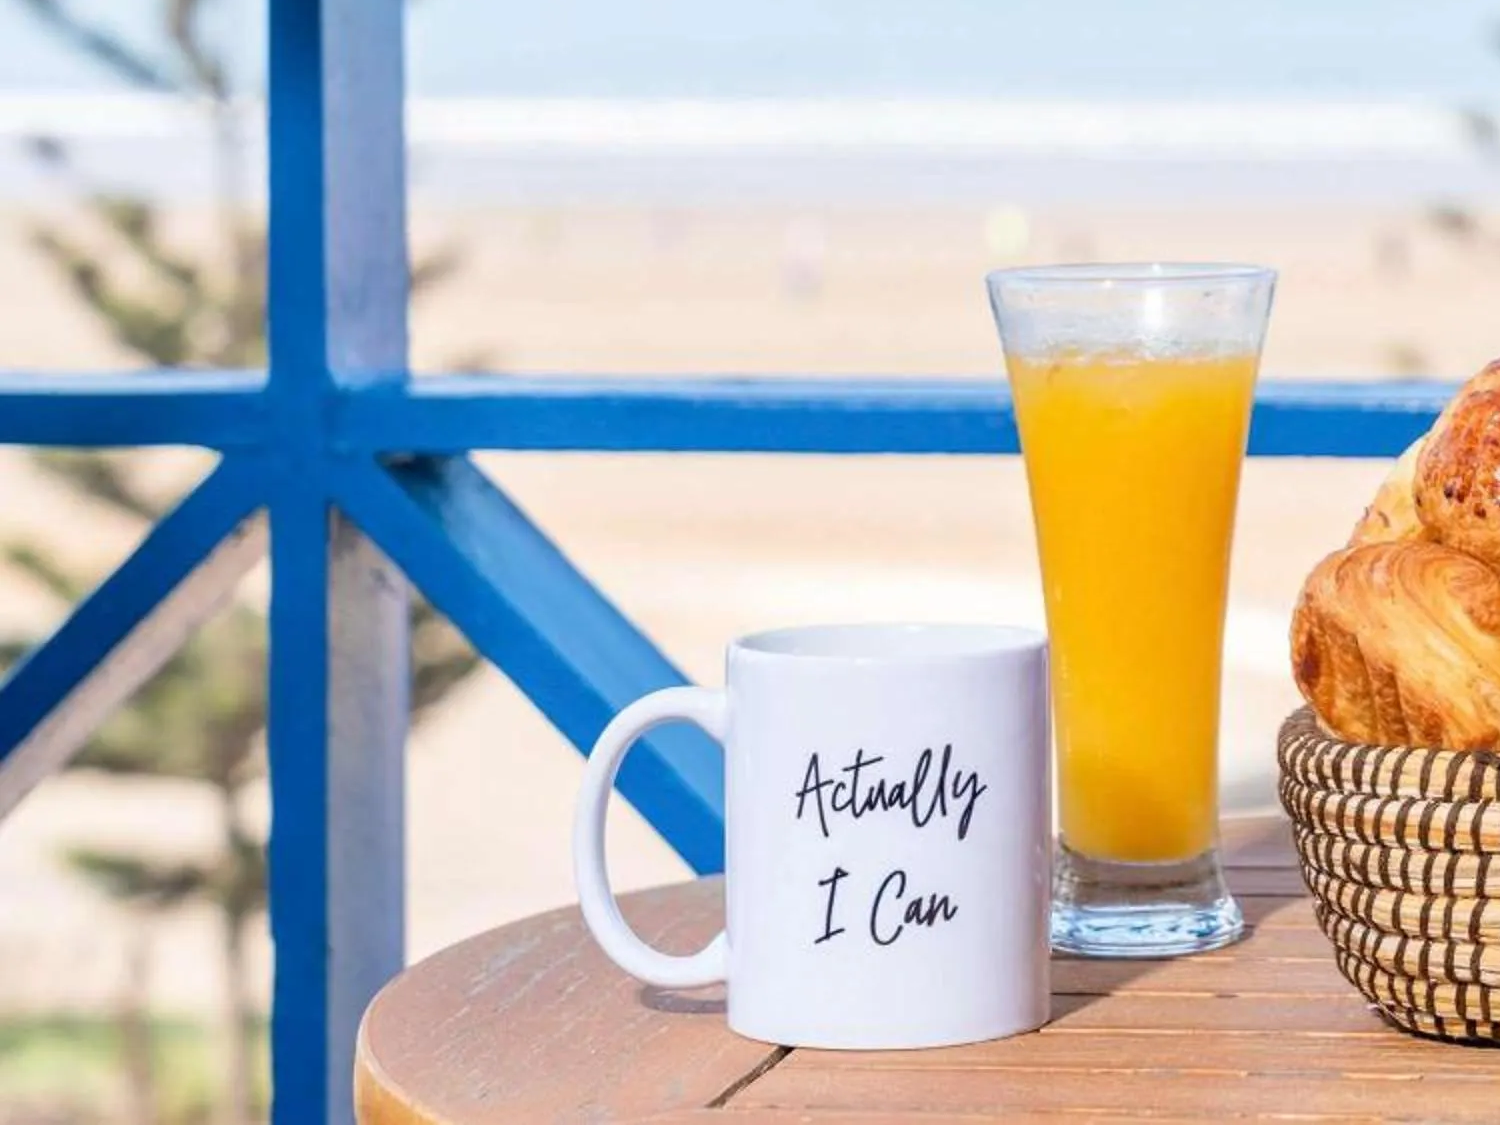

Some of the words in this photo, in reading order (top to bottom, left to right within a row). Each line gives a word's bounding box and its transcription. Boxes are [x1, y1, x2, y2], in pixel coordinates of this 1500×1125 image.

[795, 744, 988, 840] Actually
[814, 867, 850, 944] I
[870, 870, 959, 946] Can
